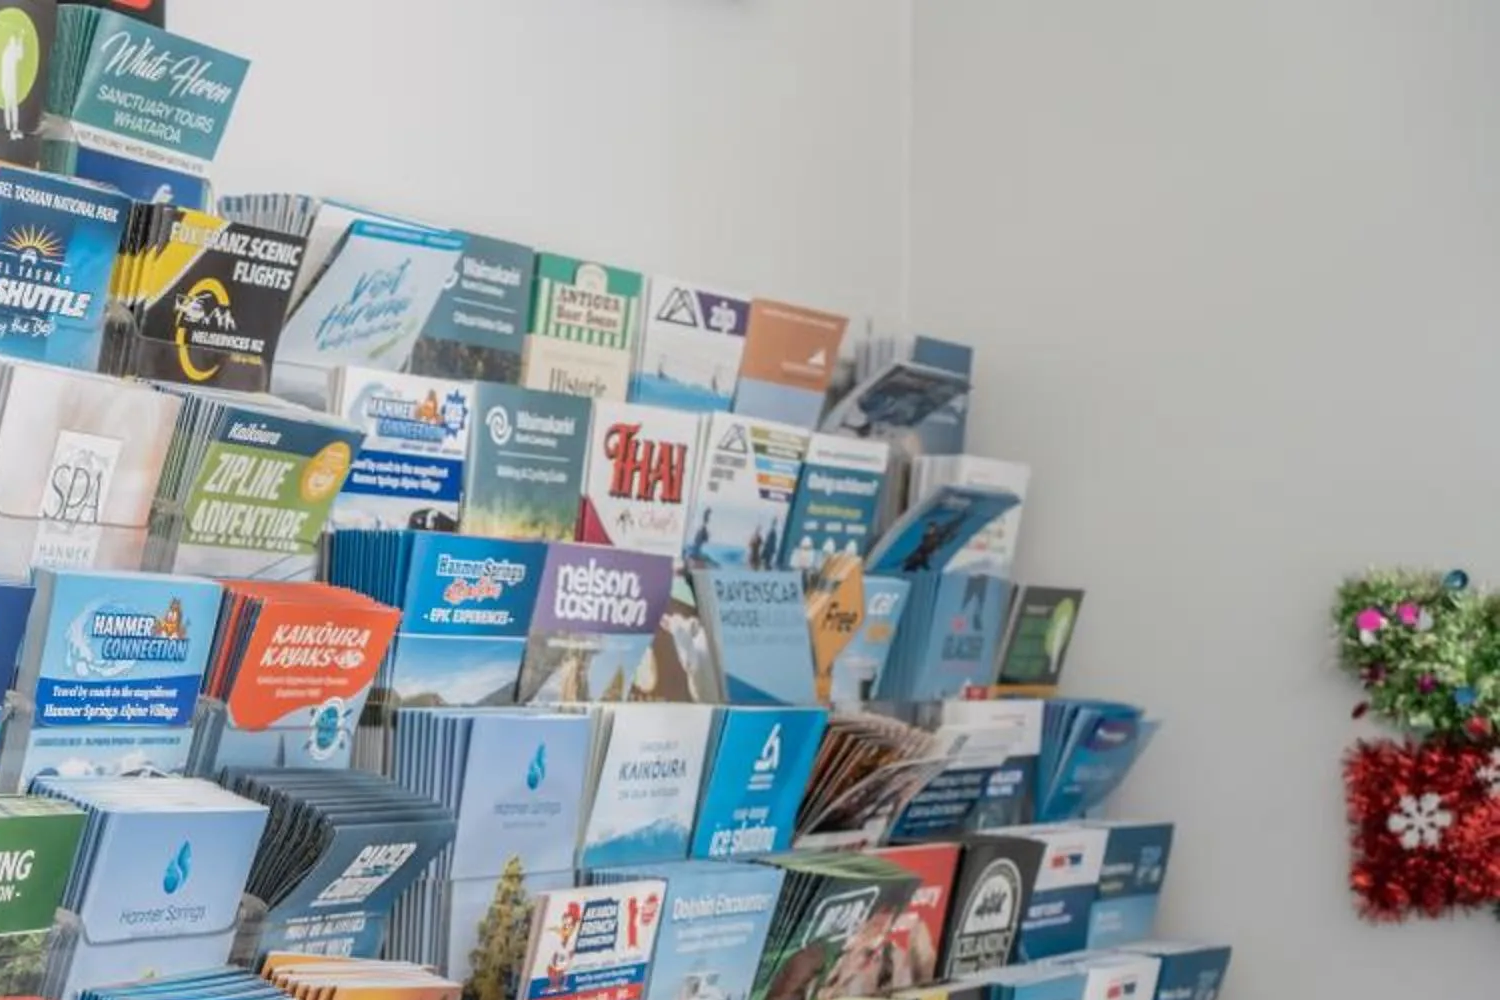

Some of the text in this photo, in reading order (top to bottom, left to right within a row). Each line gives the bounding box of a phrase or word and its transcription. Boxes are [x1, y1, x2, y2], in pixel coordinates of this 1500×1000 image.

[99, 31, 232, 104] White Heron
[98, 86, 214, 134] SANCTUARY TOURS
[15, 184, 51, 204] TASMAN
[234, 261, 293, 289] FLIGHTS
[204, 453, 294, 500] ZIPLINE
[604, 422, 687, 504] THAI
[557, 558, 641, 598] nelson
[554, 592, 648, 627] tasman
[102, 637, 188, 662] CONNECTION
[260, 646, 334, 668] KAYAKS
